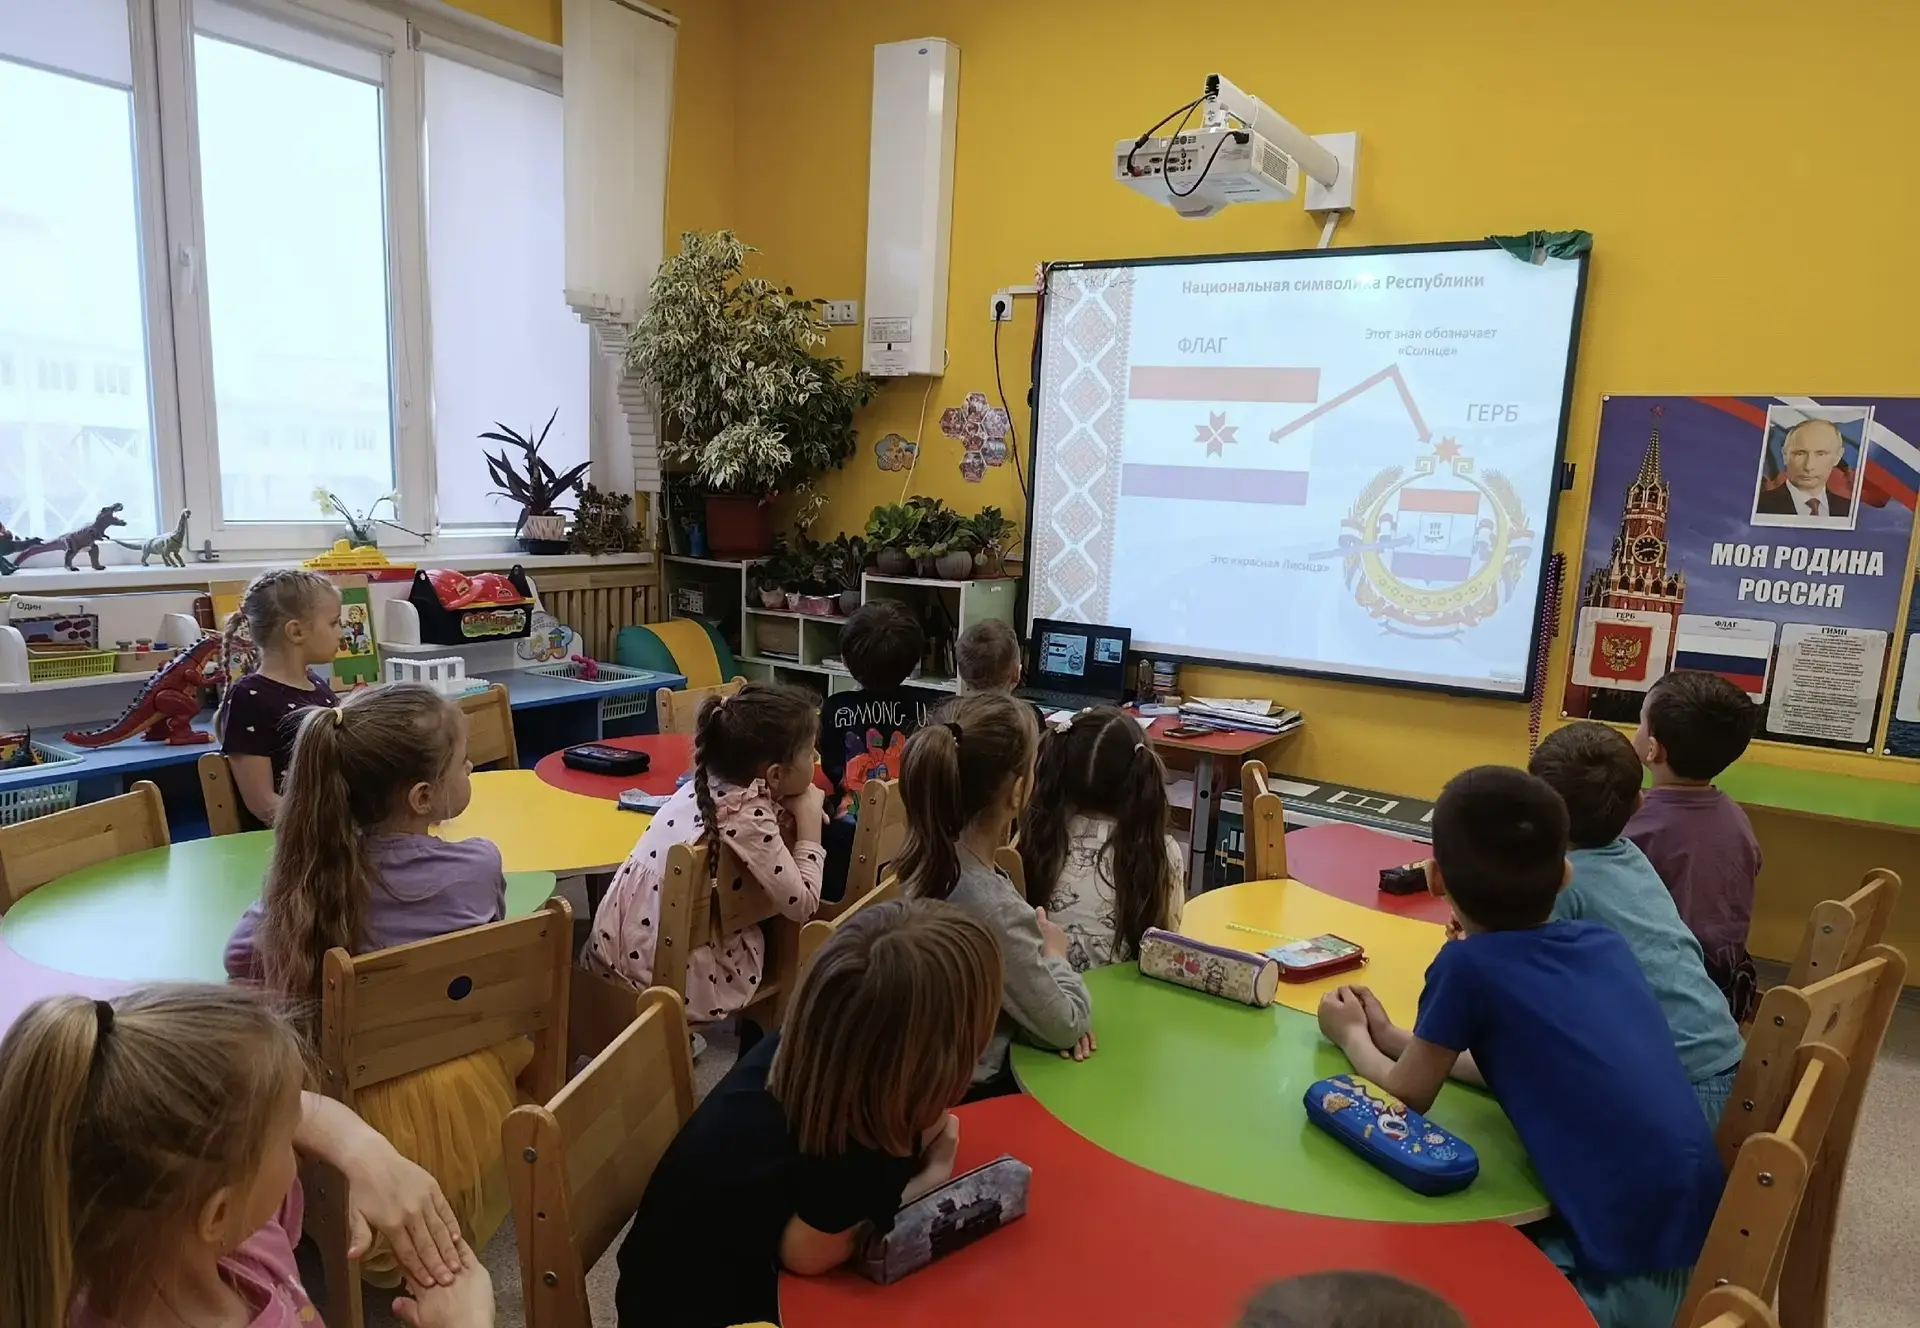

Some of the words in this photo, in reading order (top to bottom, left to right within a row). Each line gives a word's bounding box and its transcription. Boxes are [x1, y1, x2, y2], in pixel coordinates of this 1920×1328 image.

[1182, 280, 1290, 296] Национальная
[1386, 273, 1485, 292] Республики
[1365, 328, 1392, 340] Этот
[1395, 330, 1422, 340] знак
[1424, 327, 1498, 340] обозначает
[1177, 337, 1228, 354] ФЛАГ
[1398, 345, 1458, 358] «Солнце»
[1466, 404, 1519, 423] ГЕРБ
[1710, 542, 1770, 568] МОЯ
[1773, 545, 1885, 576] РОДИНА
[1737, 578, 1845, 609] РОССИЯ
[16, 601, 42, 612] Один
[1616, 612, 1636, 620] ГЕРБ
[1714, 620, 1738, 628] ФЛАГ
[1821, 627, 1848, 636] ГИМН
[916, 701, 930, 728] U
